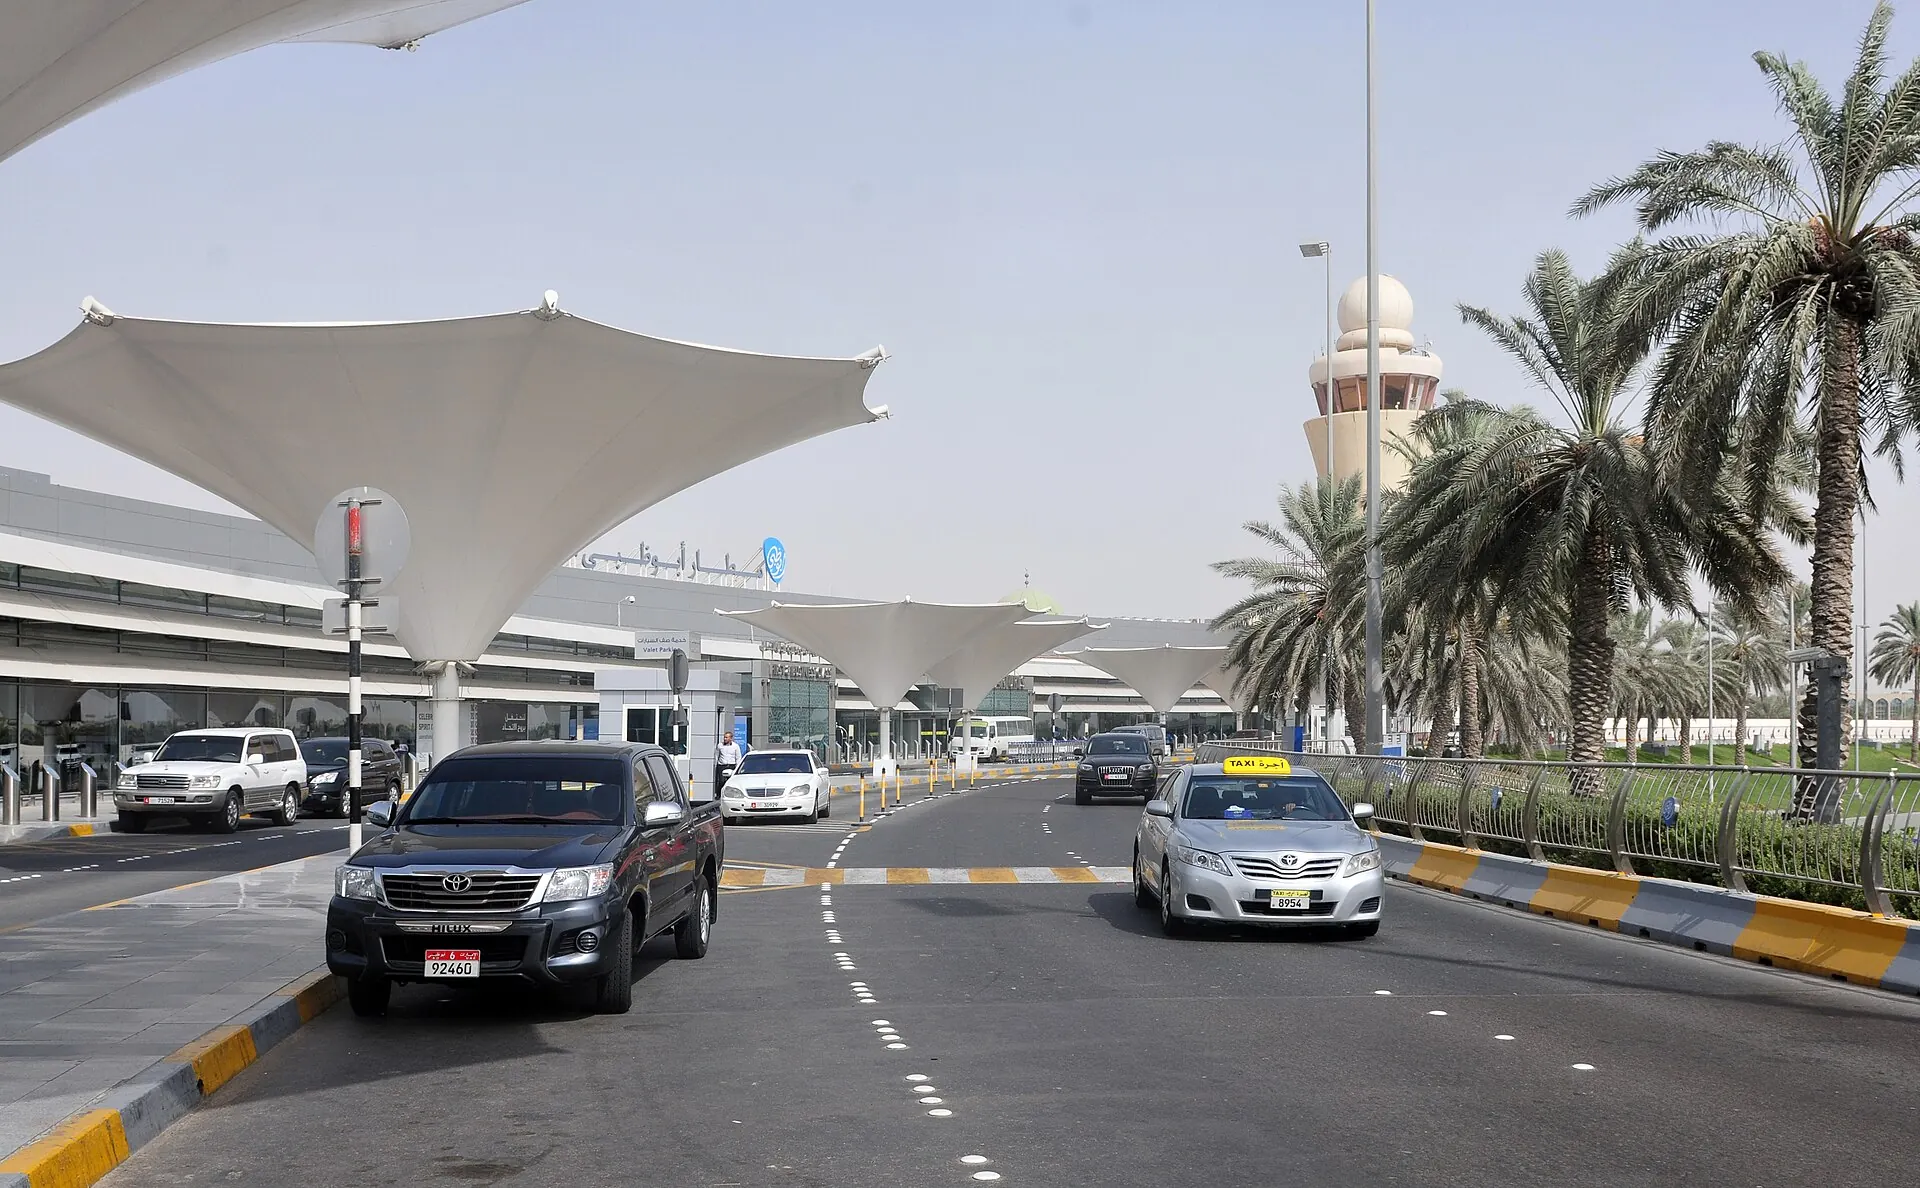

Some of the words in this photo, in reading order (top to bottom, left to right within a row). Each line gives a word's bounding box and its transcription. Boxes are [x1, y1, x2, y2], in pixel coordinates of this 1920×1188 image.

[688, 548, 763, 579] مطار
[1259, 760, 1284, 769] أجرة
[1278, 898, 1302, 908] 8954
[449, 951, 456, 960] 6
[431, 962, 472, 975] 92460
